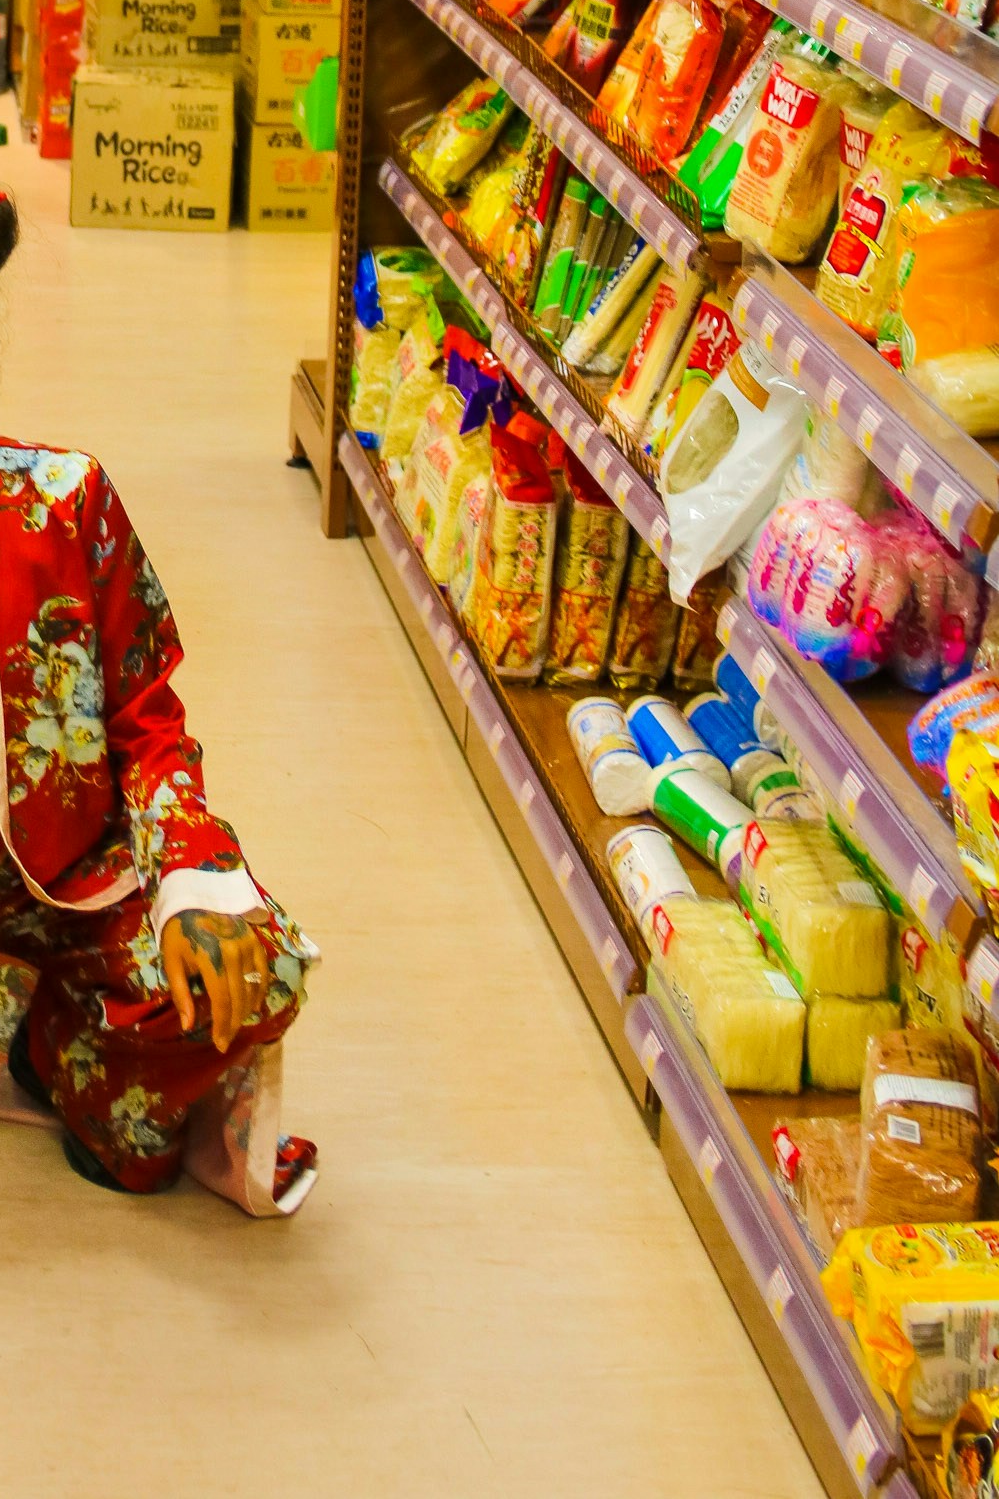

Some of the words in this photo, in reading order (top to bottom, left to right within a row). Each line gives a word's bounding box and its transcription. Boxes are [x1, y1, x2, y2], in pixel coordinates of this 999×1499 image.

[122, 0, 196, 21] Morning
[141, 17, 180, 34] Rice
[774, 75, 804, 108] WAI
[767, 92, 798, 125] WAI
[95, 131, 202, 167] Morning
[844, 123, 866, 153] WAI
[123, 159, 177, 184] Rice
